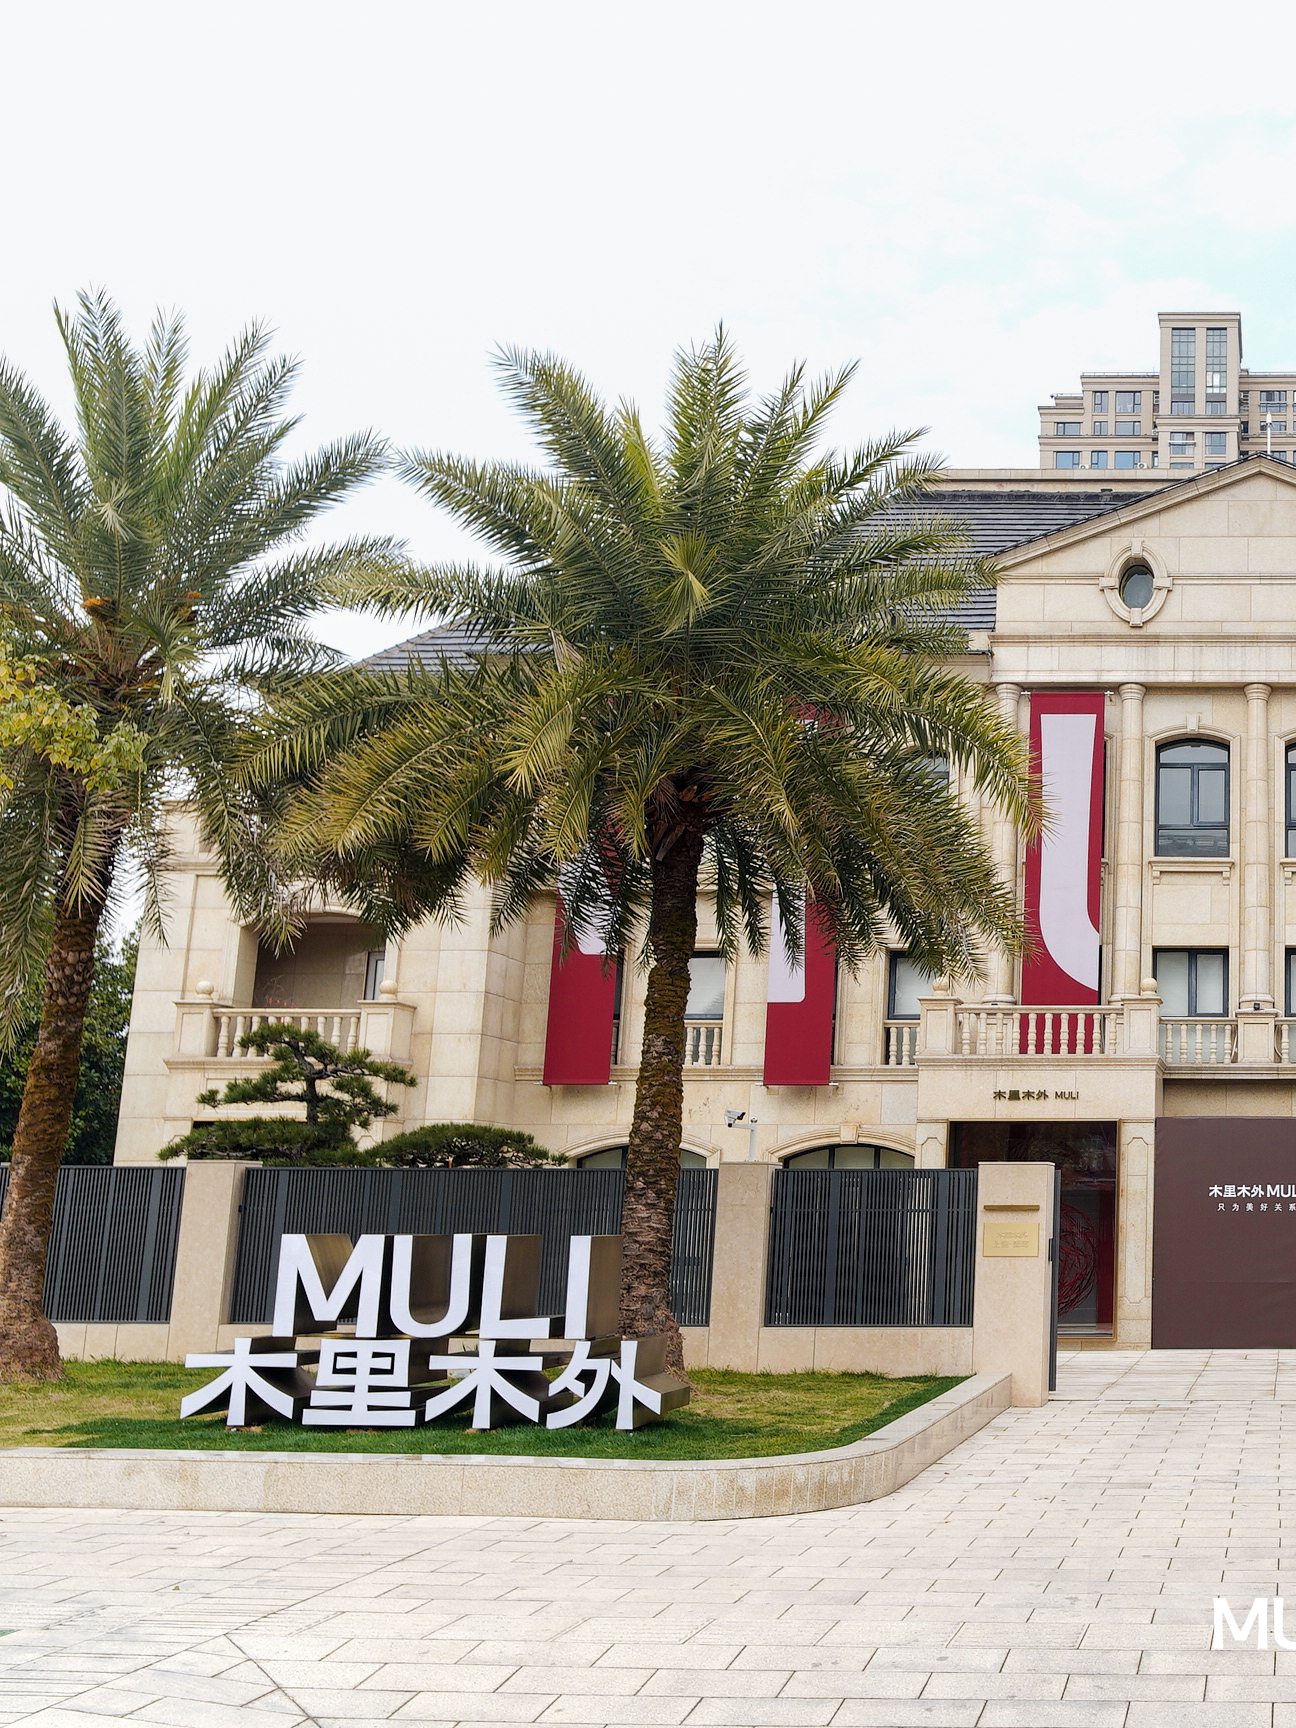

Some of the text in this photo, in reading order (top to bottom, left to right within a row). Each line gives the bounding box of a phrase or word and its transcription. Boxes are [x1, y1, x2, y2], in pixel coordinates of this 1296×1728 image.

[993, 1090, 1079, 1101] 木里木外 MULI
[1209, 1184, 1265, 1198] 木里木外
[1217, 1202, 1296, 1212] 只为美好关系
[272, 1233, 592, 1340] MULI
[180, 1336, 662, 1431] 木里木外
